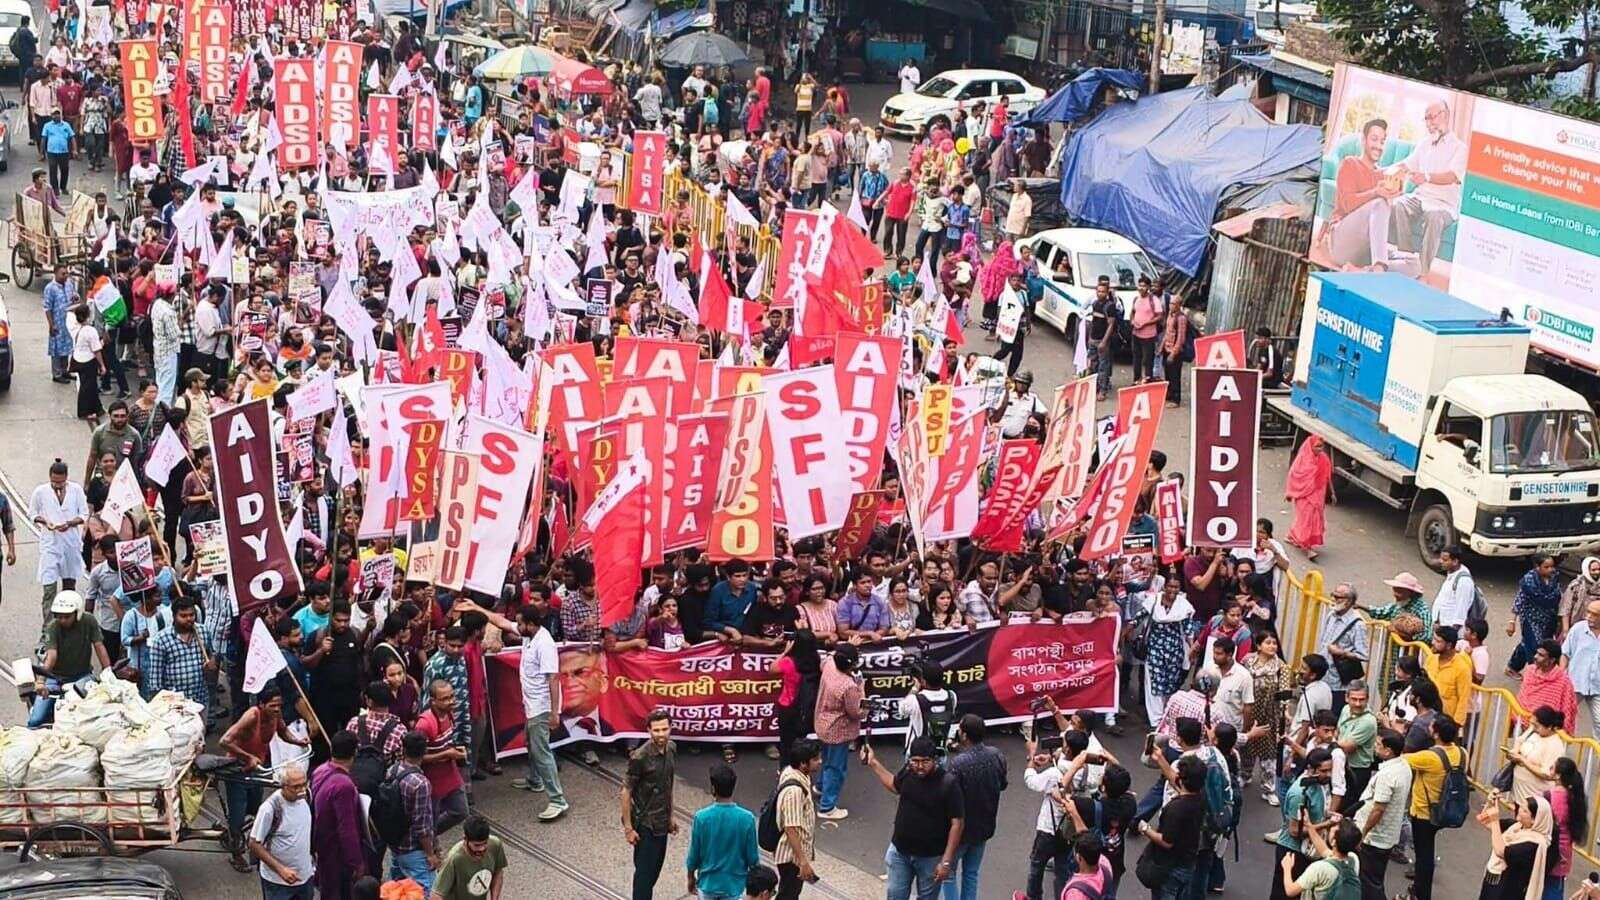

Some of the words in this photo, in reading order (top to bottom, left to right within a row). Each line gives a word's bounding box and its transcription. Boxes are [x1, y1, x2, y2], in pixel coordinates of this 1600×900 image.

[205, 8, 227, 101] AIDSO
[128, 43, 157, 137] AIDSO
[281, 63, 310, 164] AIDSO
[418, 98, 430, 145] AISA
[377, 99, 389, 148] AIS
[640, 137, 655, 205] AISA
[1482, 144, 1492, 155] A
[1494, 147, 1531, 167] friendly
[1533, 158, 1567, 175] advice
[1569, 167, 1591, 182] that
[1502, 163, 1539, 182] change
[1541, 174, 1564, 188] your
[1471, 190, 1491, 204] Avail
[1491, 195, 1516, 214] Home
[1517, 203, 1542, 220] Loans
[1543, 211, 1564, 227] from
[1565, 218, 1583, 232] IDBI
[1361, 327, 1384, 353] HIRE
[1543, 312, 1565, 331] IDBI
[1566, 325, 1592, 341] BANK
[723, 396, 756, 508] PSU
[779, 380, 827, 527] SFI
[926, 390, 947, 453] PSU
[1062, 382, 1089, 496] PSU
[408, 424, 437, 519] DYSA
[678, 424, 709, 534] AISA
[1091, 392, 1151, 552] AIDSO
[1207, 376, 1241, 543] AIDYO
[1571, 481, 1588, 493] HIRE
[226, 411, 284, 598] AIDYO
[441, 455, 470, 585] PSU
[465, 432, 519, 580] SFI
[1162, 491, 1177, 556] AIDSO
[680, 653, 735, 673] যন্তর
[957, 664, 986, 684] চাই
[1007, 659, 1057, 677] সংগঠন
[1012, 684, 1025, 695] ও
[727, 703, 775, 717] সমস্ত
